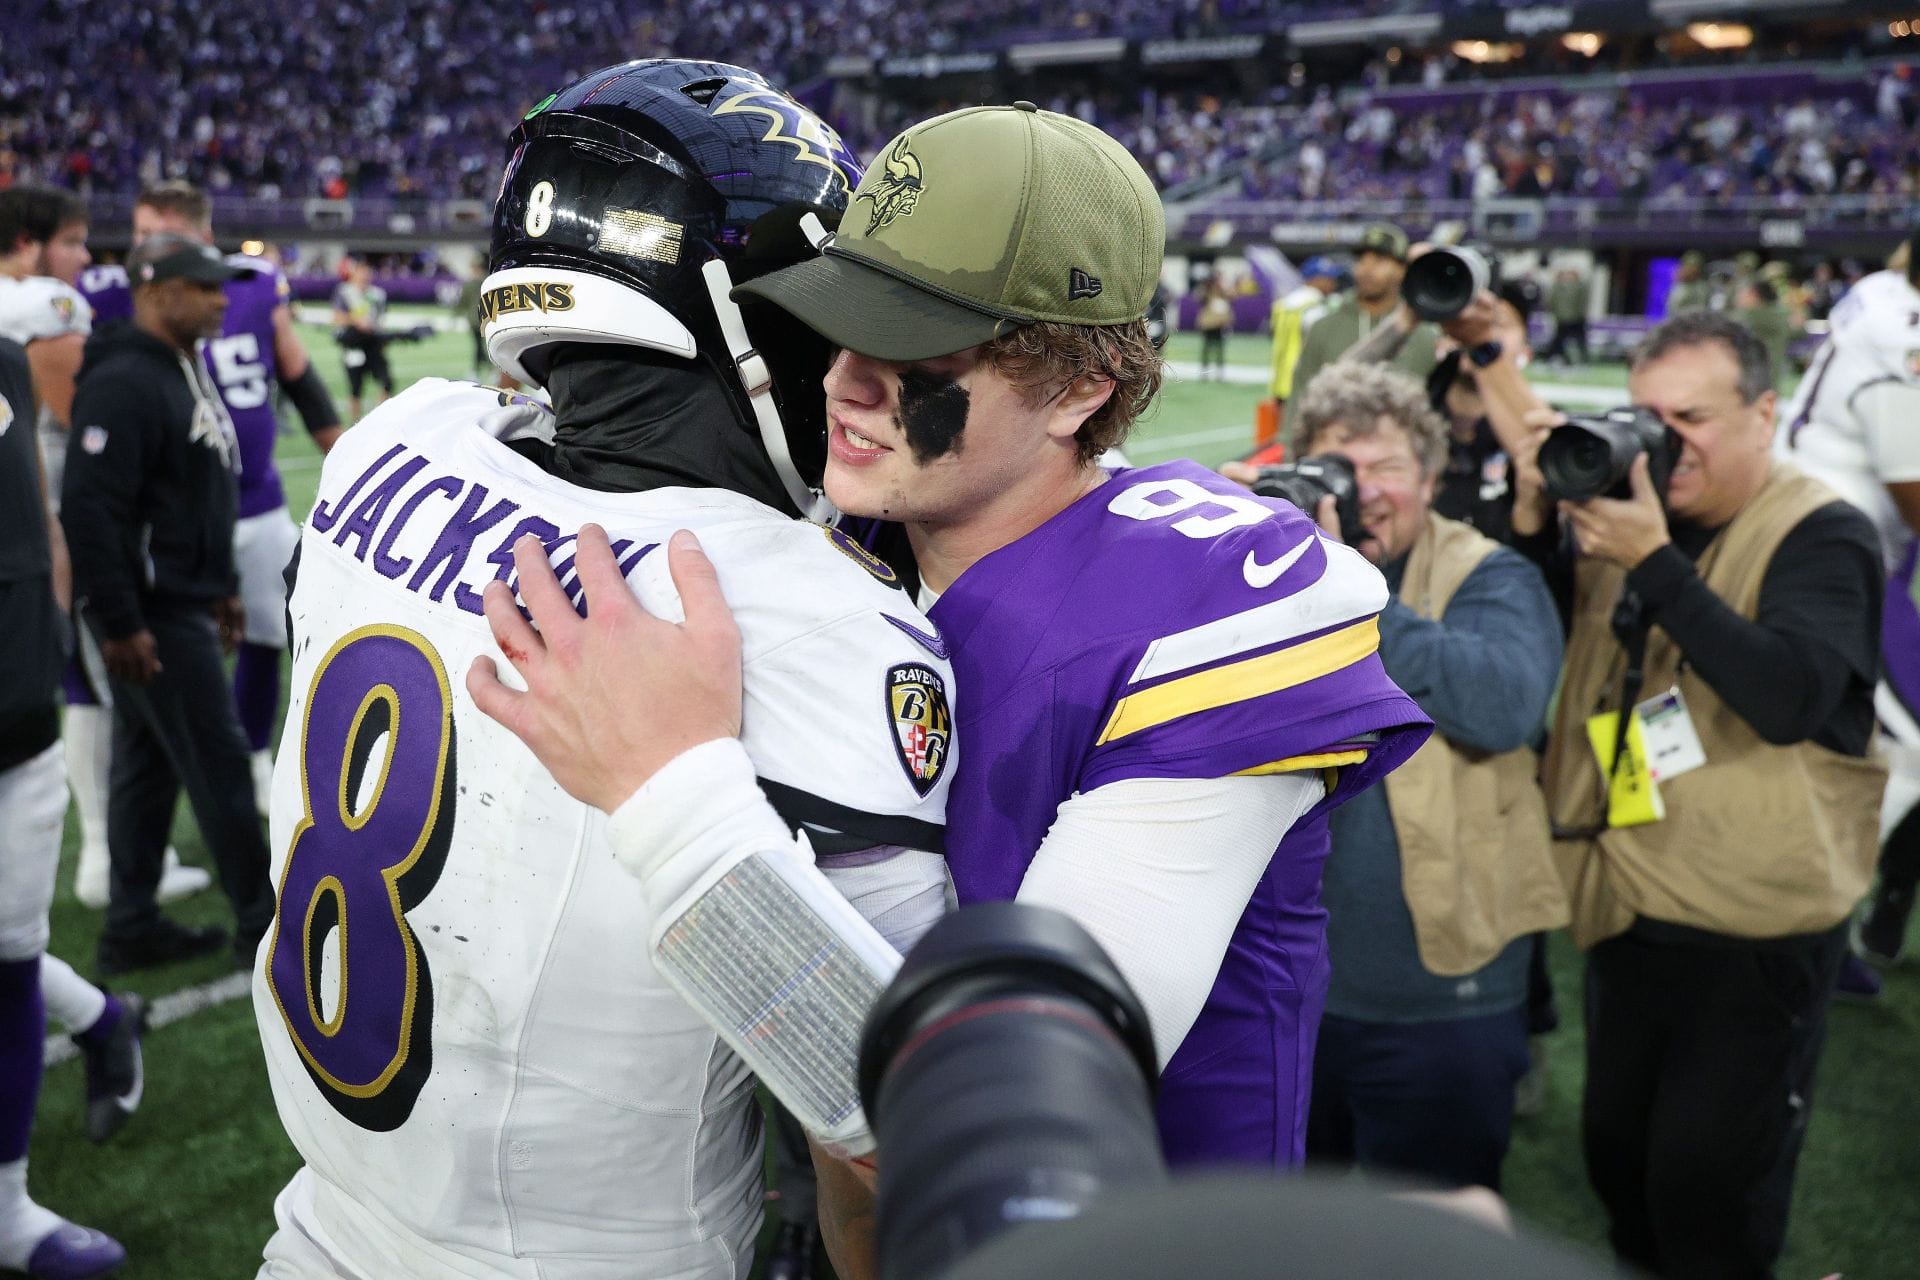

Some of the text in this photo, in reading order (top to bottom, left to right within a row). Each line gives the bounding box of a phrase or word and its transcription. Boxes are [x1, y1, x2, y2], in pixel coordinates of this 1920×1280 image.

[525, 180, 554, 238] 8
[1107, 479, 1276, 539] 9
[893, 669, 942, 692] RAVENS
[265, 623, 457, 1132] 8
